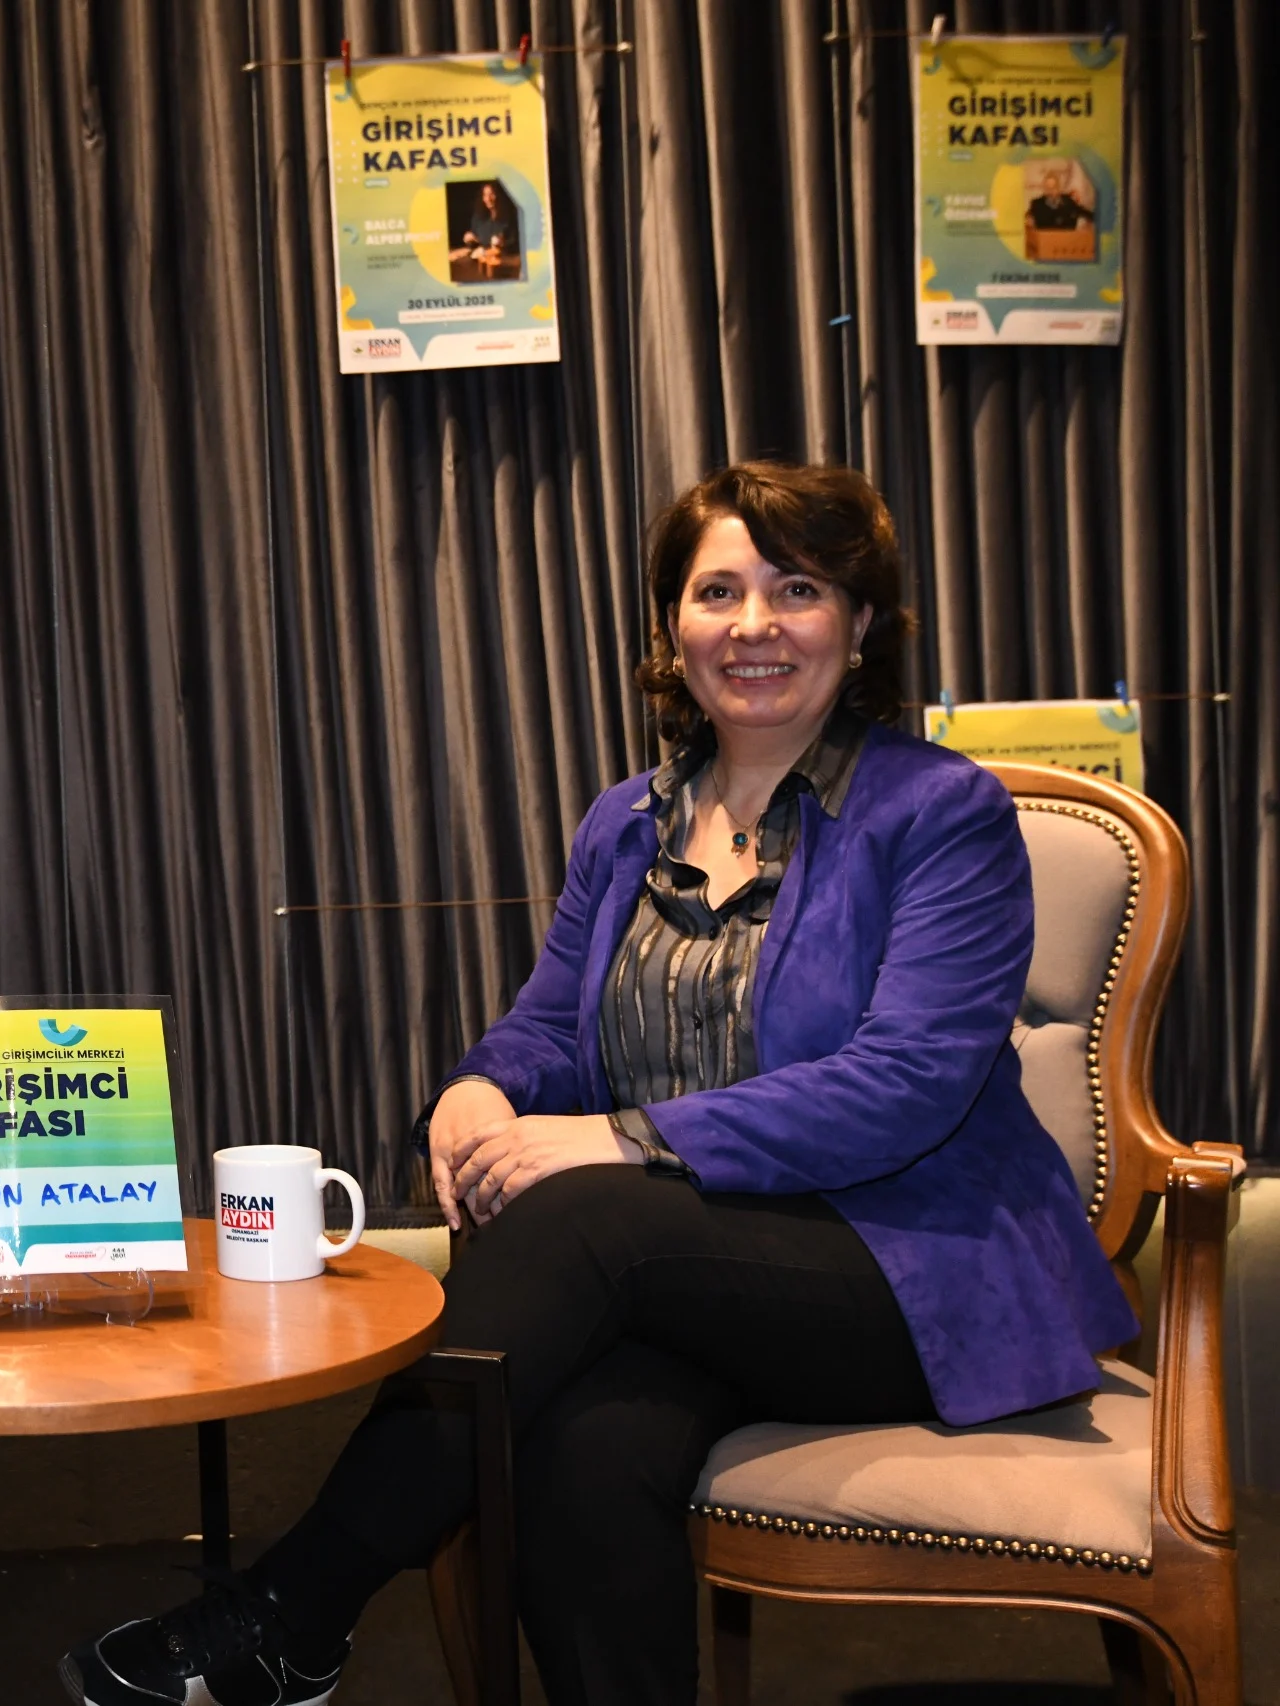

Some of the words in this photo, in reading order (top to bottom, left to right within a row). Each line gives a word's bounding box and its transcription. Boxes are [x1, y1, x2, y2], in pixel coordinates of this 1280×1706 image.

[948, 90, 1093, 119] GİRİŞİMCİ
[362, 110, 513, 143] GİRİŞİMCİ
[948, 124, 1058, 145] KAFASI
[363, 147, 478, 172] KAFASI
[426, 296, 461, 308] EYLÜL
[2, 1048, 74, 1063] GİRİŞİMCİLİK
[77, 1047, 125, 1059] MERKEZİ
[41, 1180, 157, 1207] ATALAY
[221, 1192, 274, 1211] ERKAN
[222, 1208, 272, 1229] AYDIN
